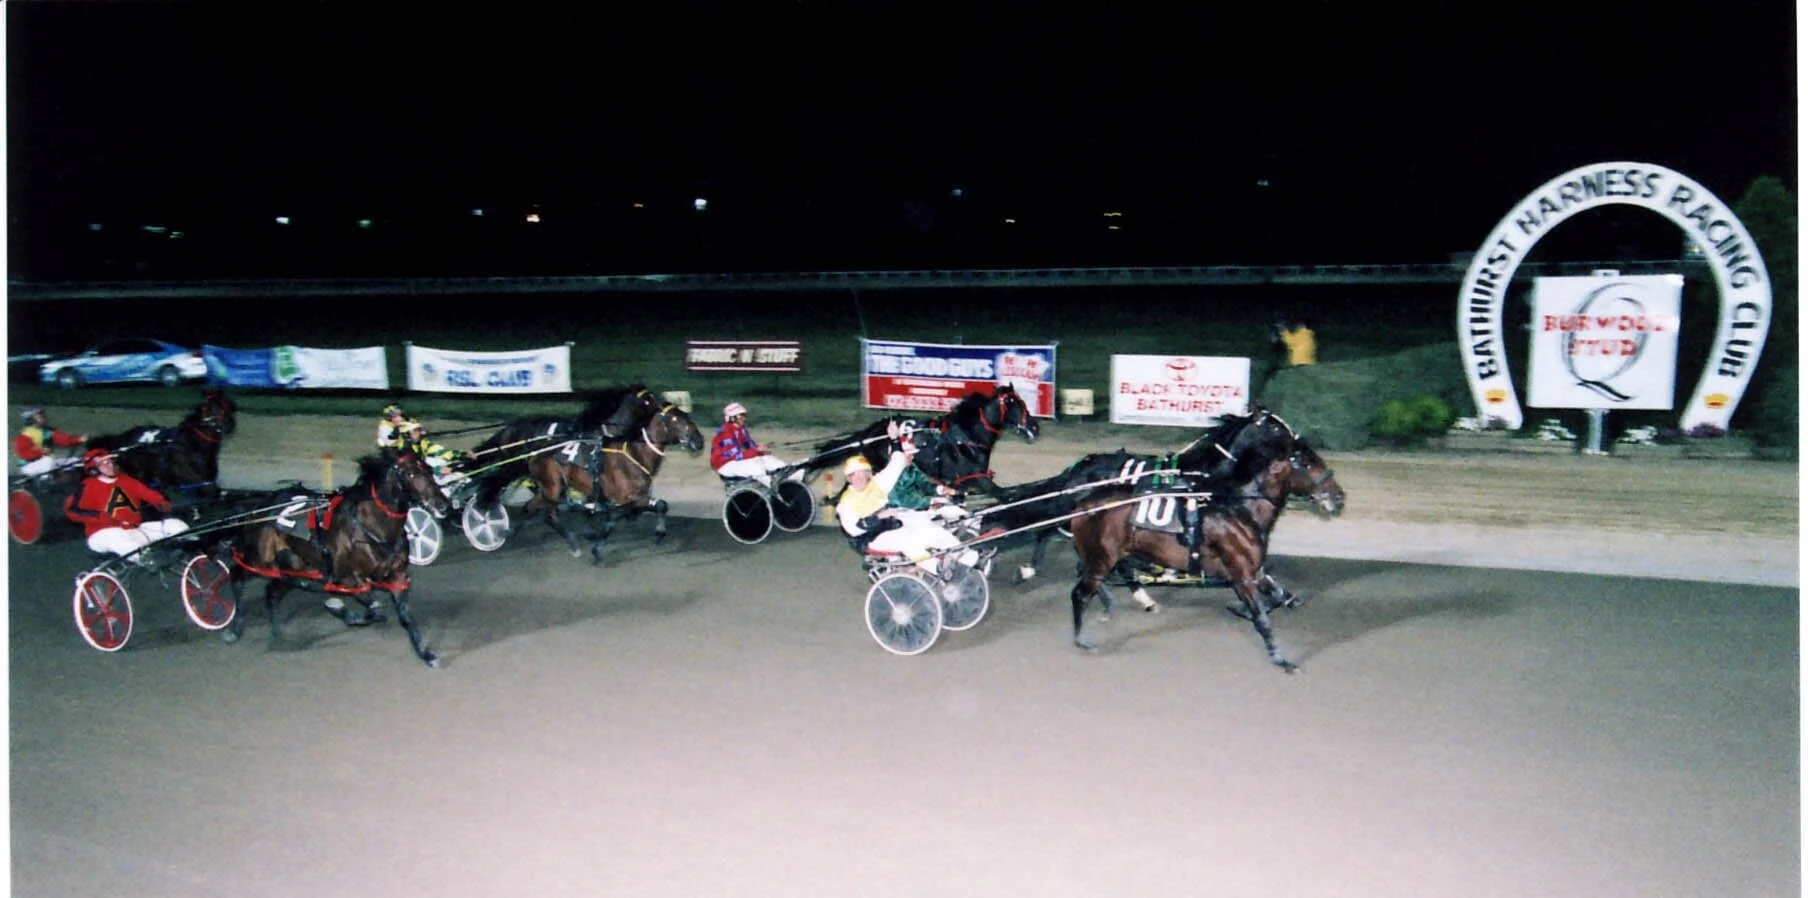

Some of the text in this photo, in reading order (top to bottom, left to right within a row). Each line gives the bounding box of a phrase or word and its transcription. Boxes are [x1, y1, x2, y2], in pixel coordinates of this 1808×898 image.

[1470, 169, 1761, 380] BATHURST HARNESS RACING CLUB
[1568, 339, 1638, 355] STUD
[869, 355, 899, 373] THE
[901, 357, 948, 376] GOOD
[949, 359, 993, 378] GUYS
[1120, 382, 1242, 397] BLACK TOYOTA
[1137, 398, 1224, 413] BATHURST
[561, 441, 580, 462] 4
[1119, 459, 1147, 484] 11
[105, 486, 139, 518] A
[1136, 496, 1176, 526] 10
